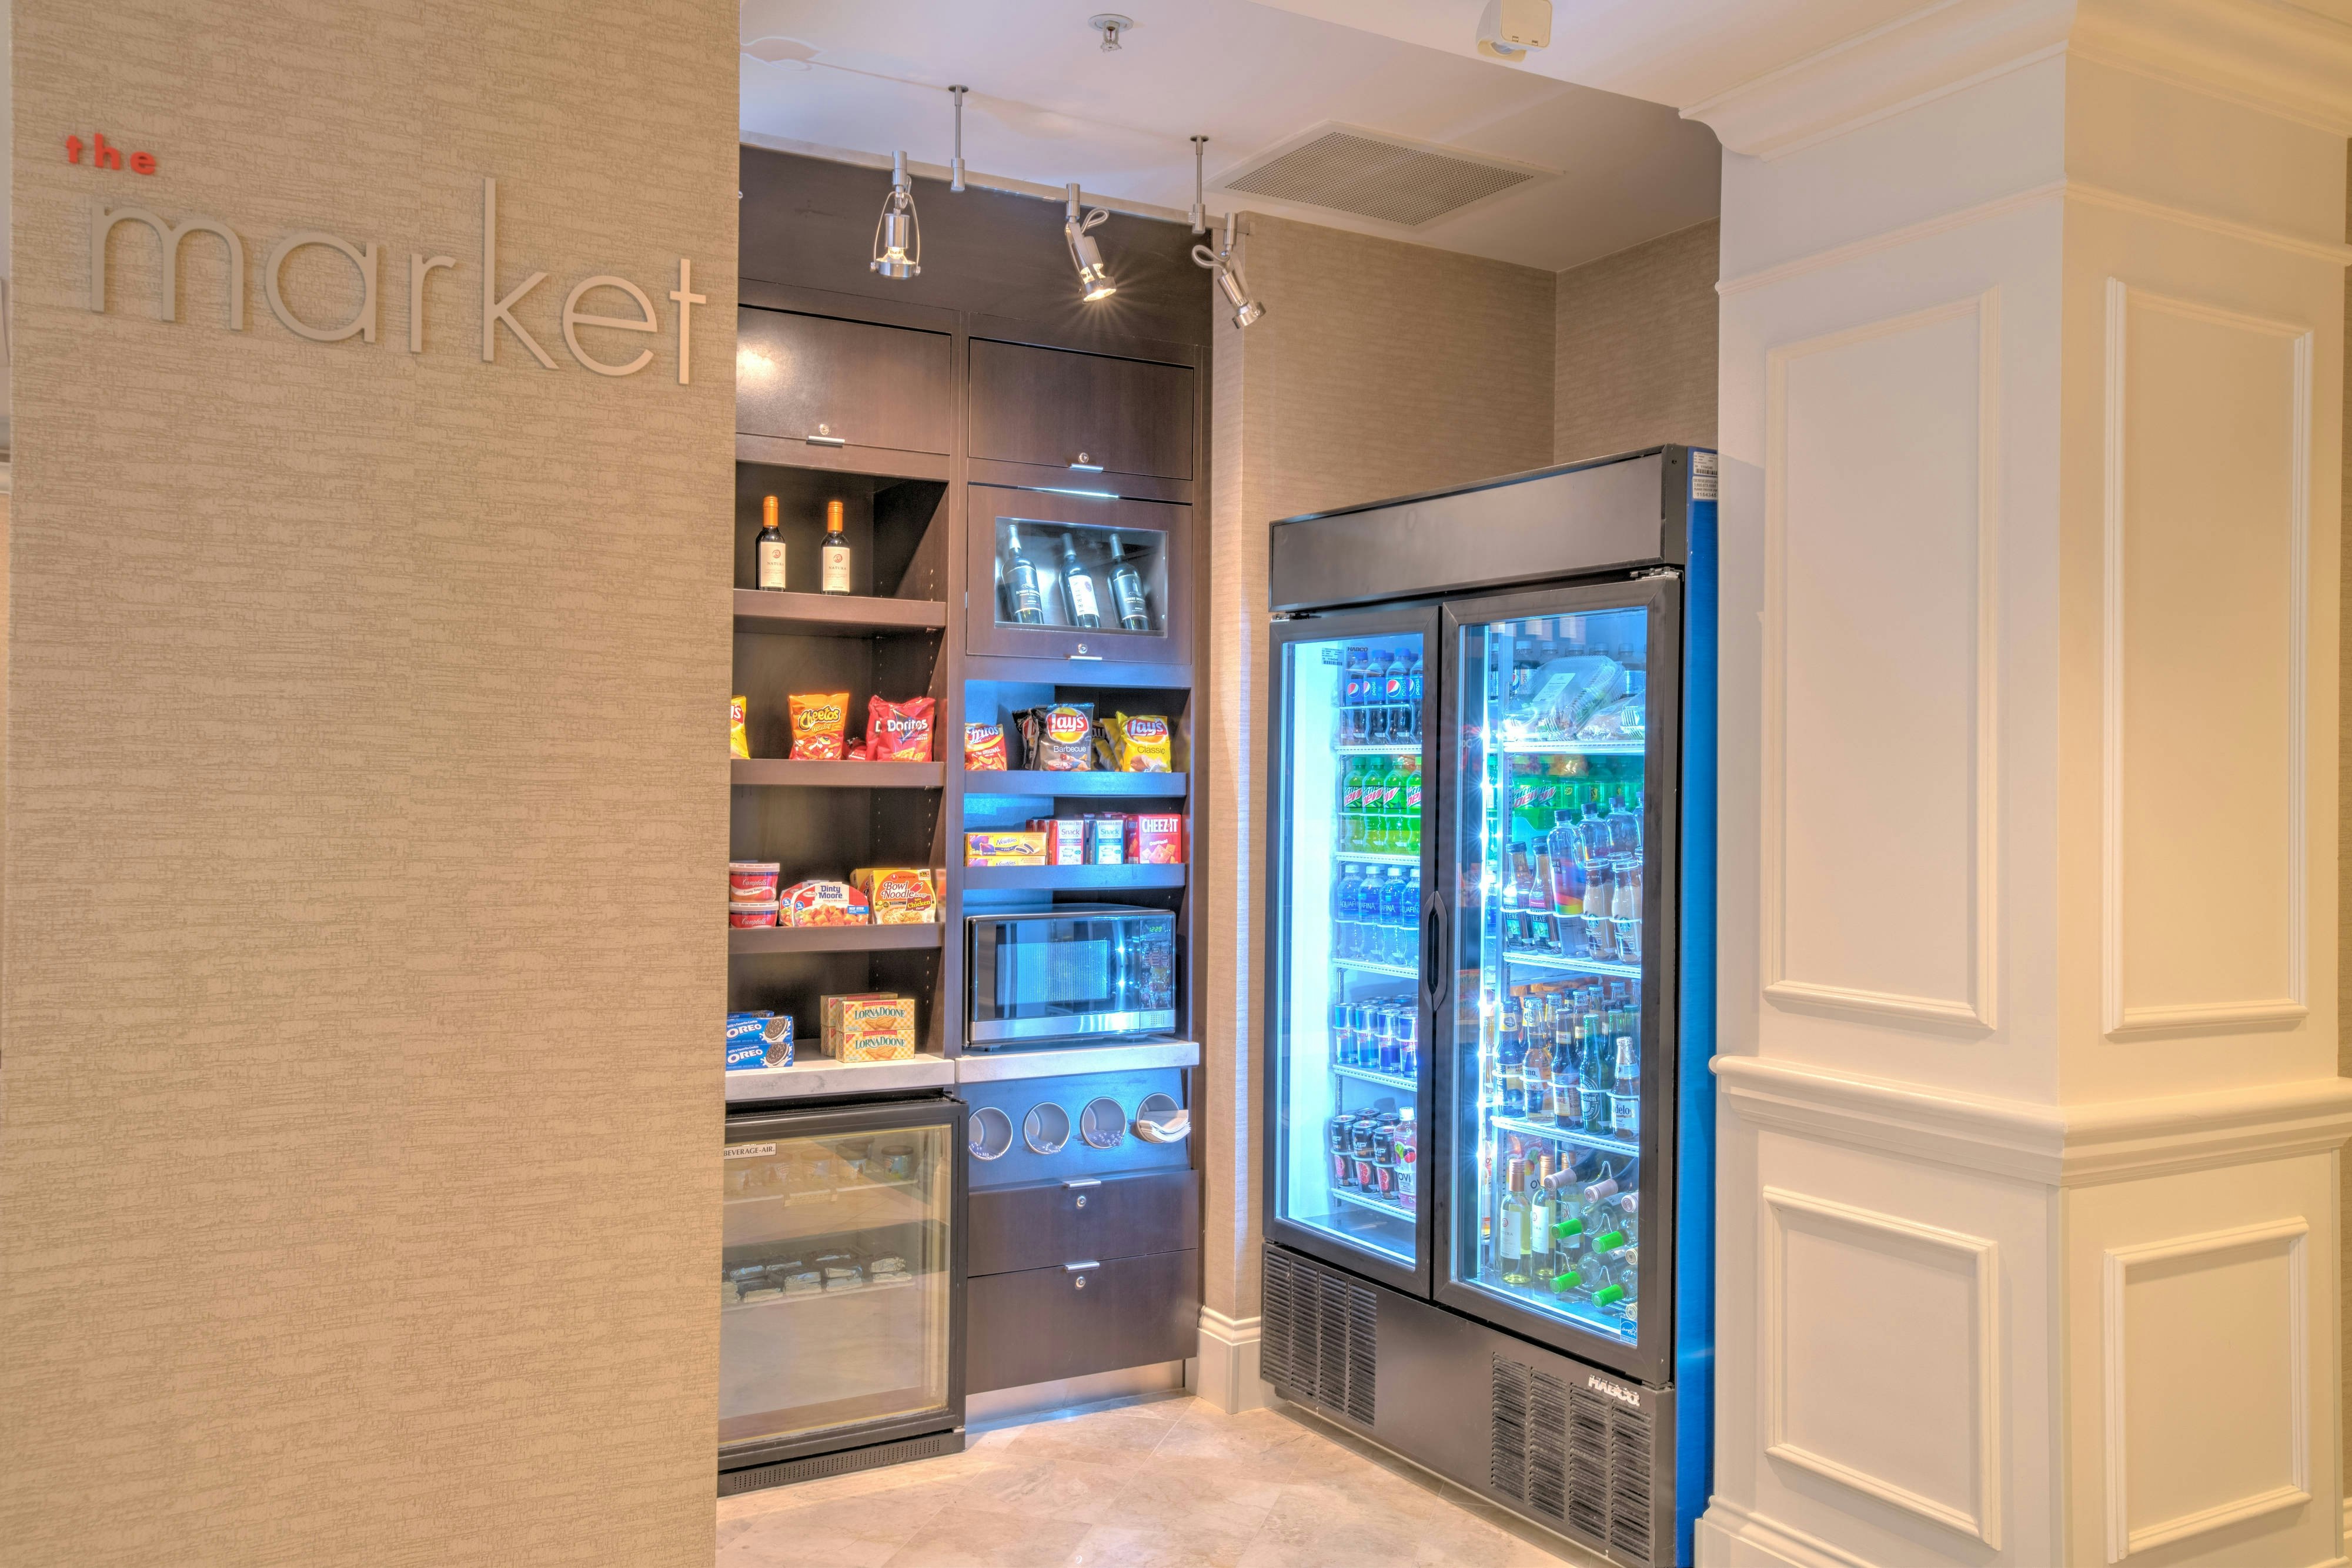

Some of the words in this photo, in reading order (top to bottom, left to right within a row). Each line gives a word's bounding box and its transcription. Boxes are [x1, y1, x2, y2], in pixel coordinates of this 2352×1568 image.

[65, 133, 156, 175] the
[89, 176, 707, 386] market
[798, 705, 841, 731] Cheetos
[1051, 714, 1085, 733] Lay's
[887, 718, 929, 733] Doritos
[1130, 718, 1164, 737] Lay's
[1137, 745, 1165, 754] Classic
[820, 885, 841, 893] Dinty
[883, 881, 908, 891] Bowl
[881, 889, 914, 899] Noodle
[907, 900, 931, 908] Chicken
[854, 1008, 881, 1020] LORNA
[880, 1007, 906, 1018] DOONE
[726, 1024, 762, 1038] OREO
[855, 1038, 881, 1050] LORNA
[880, 1036, 906, 1047] DOONE
[727, 1049, 763, 1064] OREO
[1615, 1105, 1630, 1115] delo
[724, 1146, 773, 1156] BEVERAGE-AIR
[1588, 1374, 1641, 1405] HABCO
